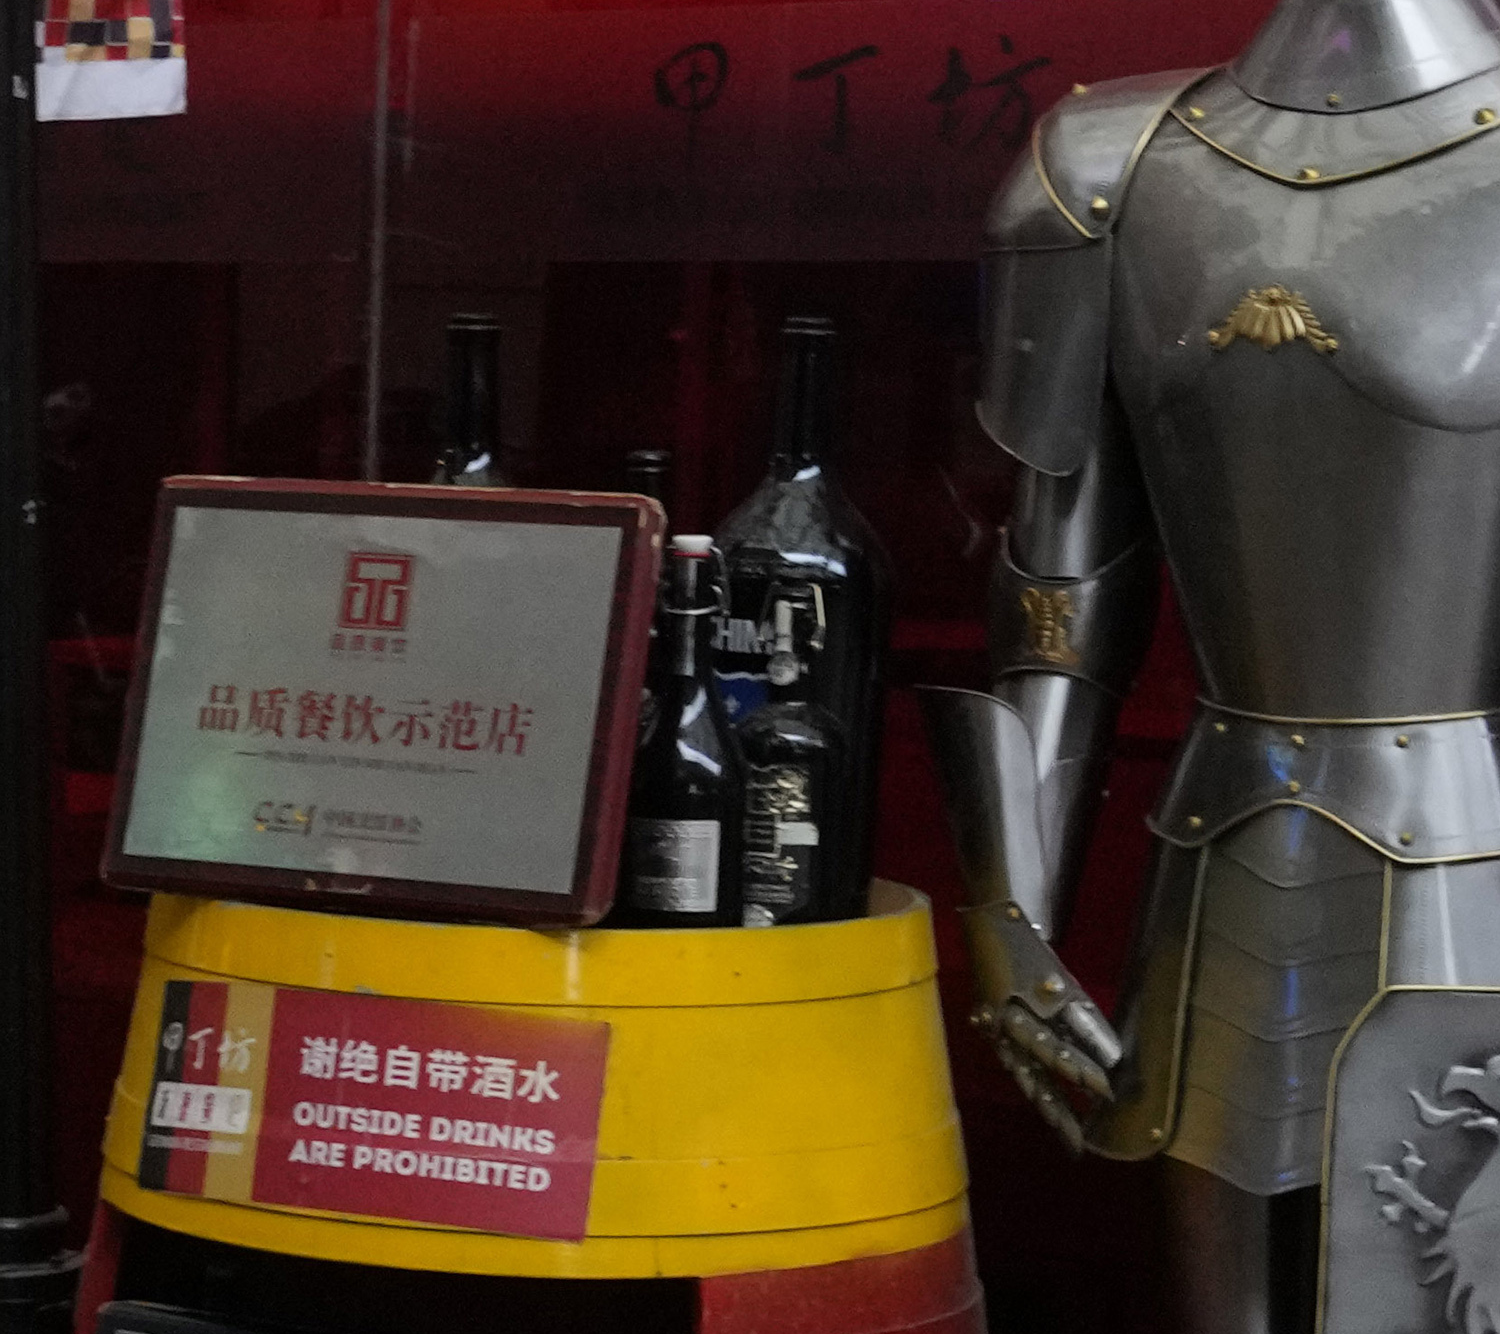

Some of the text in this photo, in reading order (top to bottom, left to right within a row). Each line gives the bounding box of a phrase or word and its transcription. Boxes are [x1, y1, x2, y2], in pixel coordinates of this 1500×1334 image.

[197, 684, 535, 757] 品质餐饮示范店
[300, 1035, 560, 1104] 谢绝自带酒水
[293, 1101, 423, 1141] OUTSIDE
[429, 1117, 557, 1156] DRINKS
[287, 1139, 347, 1167] ARE
[352, 1146, 552, 1193] PROHIBITED
